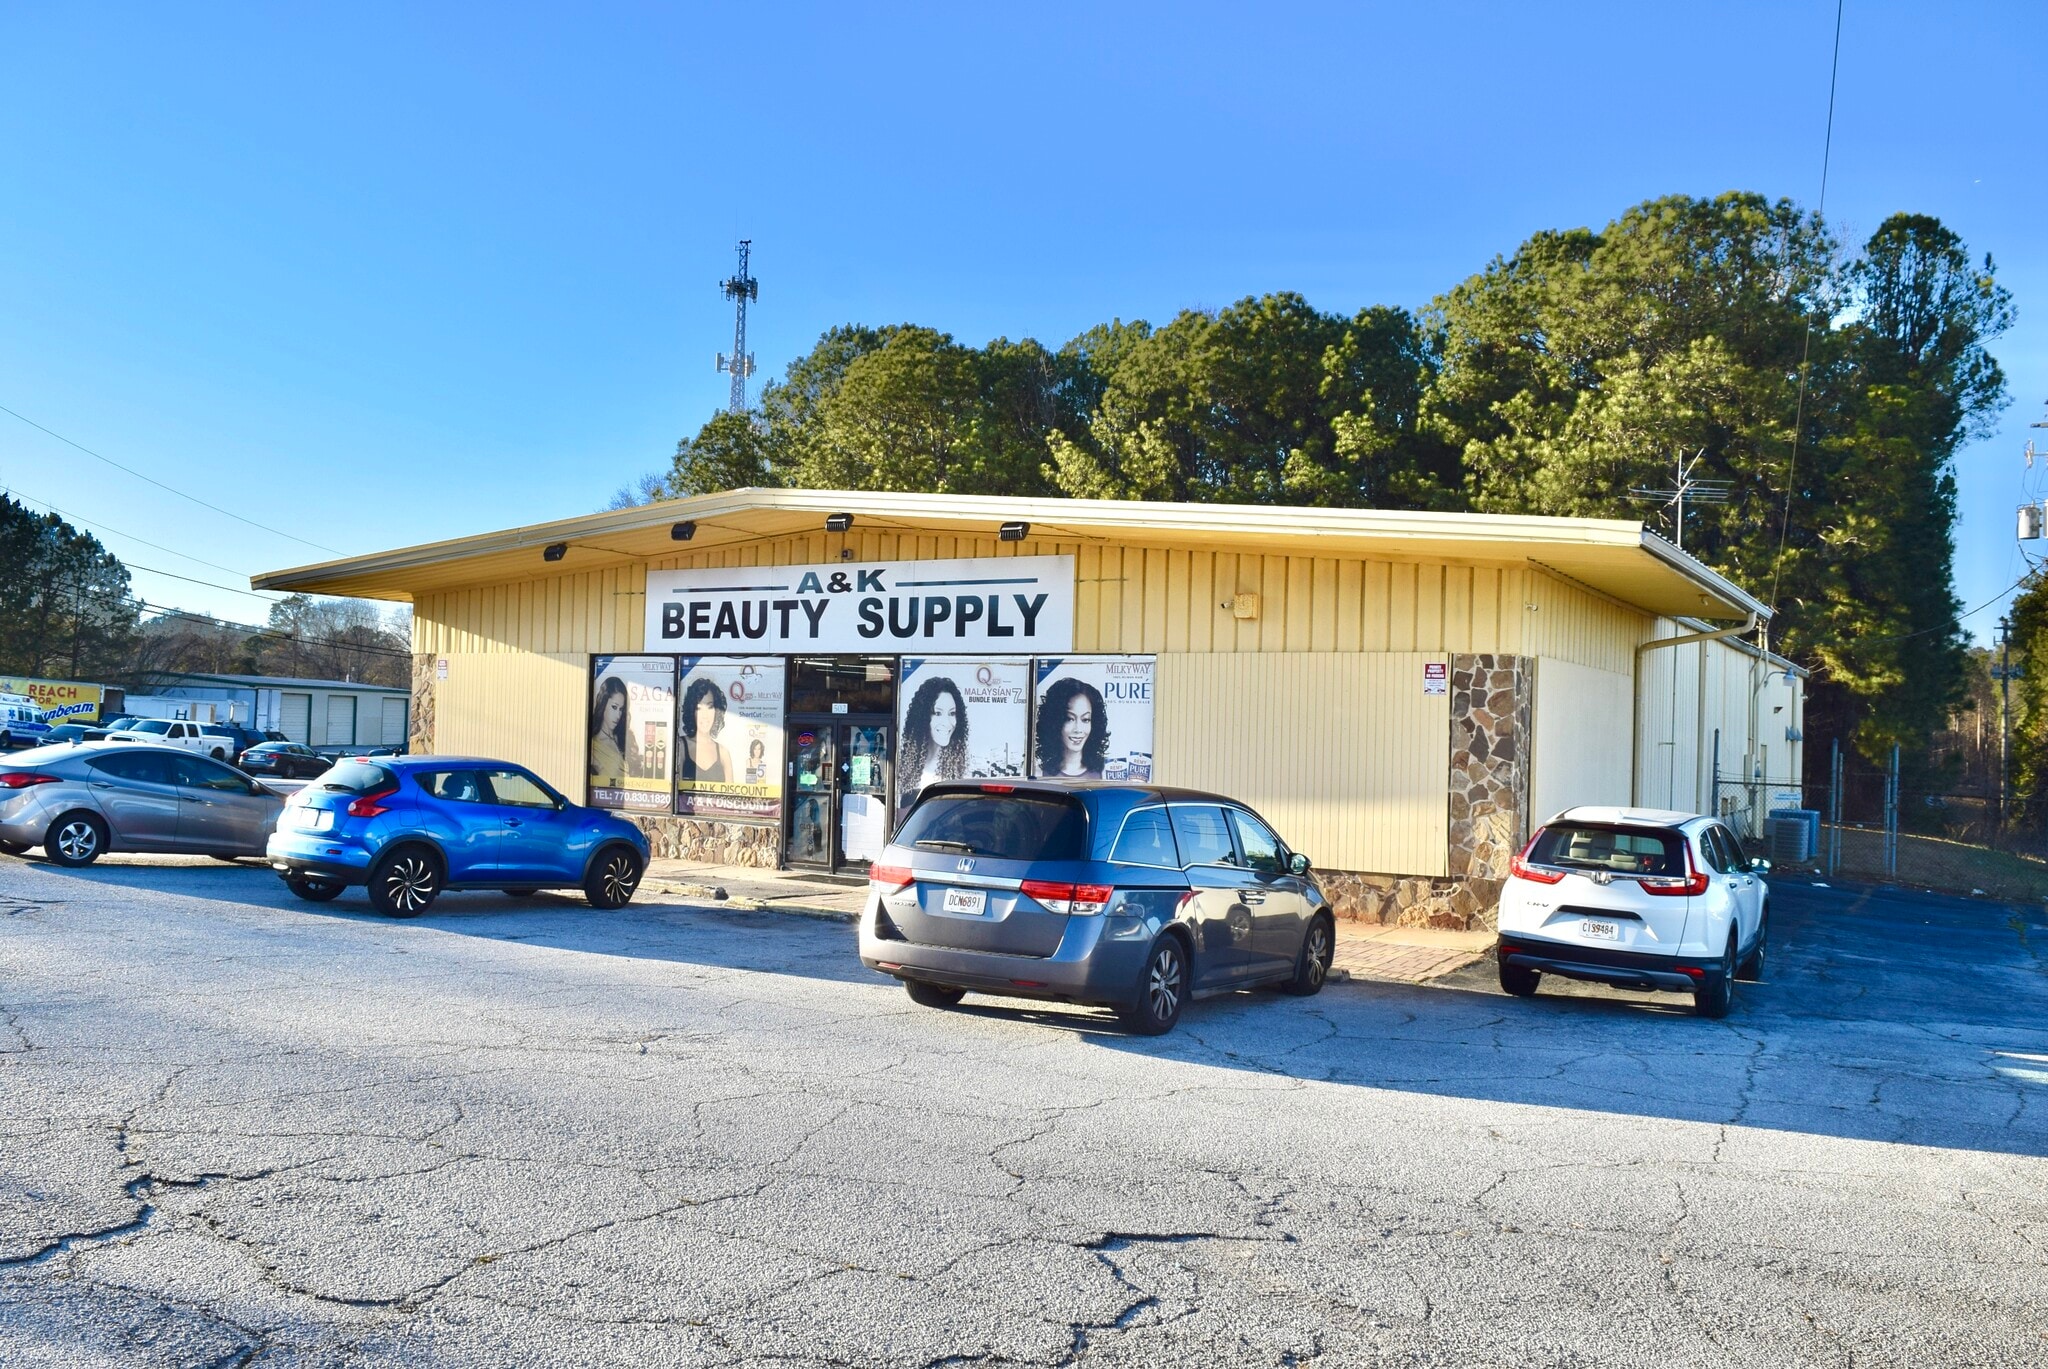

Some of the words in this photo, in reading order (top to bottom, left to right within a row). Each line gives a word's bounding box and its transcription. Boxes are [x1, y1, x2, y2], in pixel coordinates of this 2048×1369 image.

[662, 599, 830, 639] BEAUTY
[857, 594, 1049, 638] SUPPLY
[29, 684, 77, 698] REACH
[630, 686, 673, 701] SAGA
[42, 703, 95, 720] unbeam
[594, 790, 612, 800] TEL:
[720, 784, 768, 796] DISCOUNT
[686, 796, 694, 806] A
[707, 798, 715, 807] K
[716, 799, 769, 811] DISCOUNT
